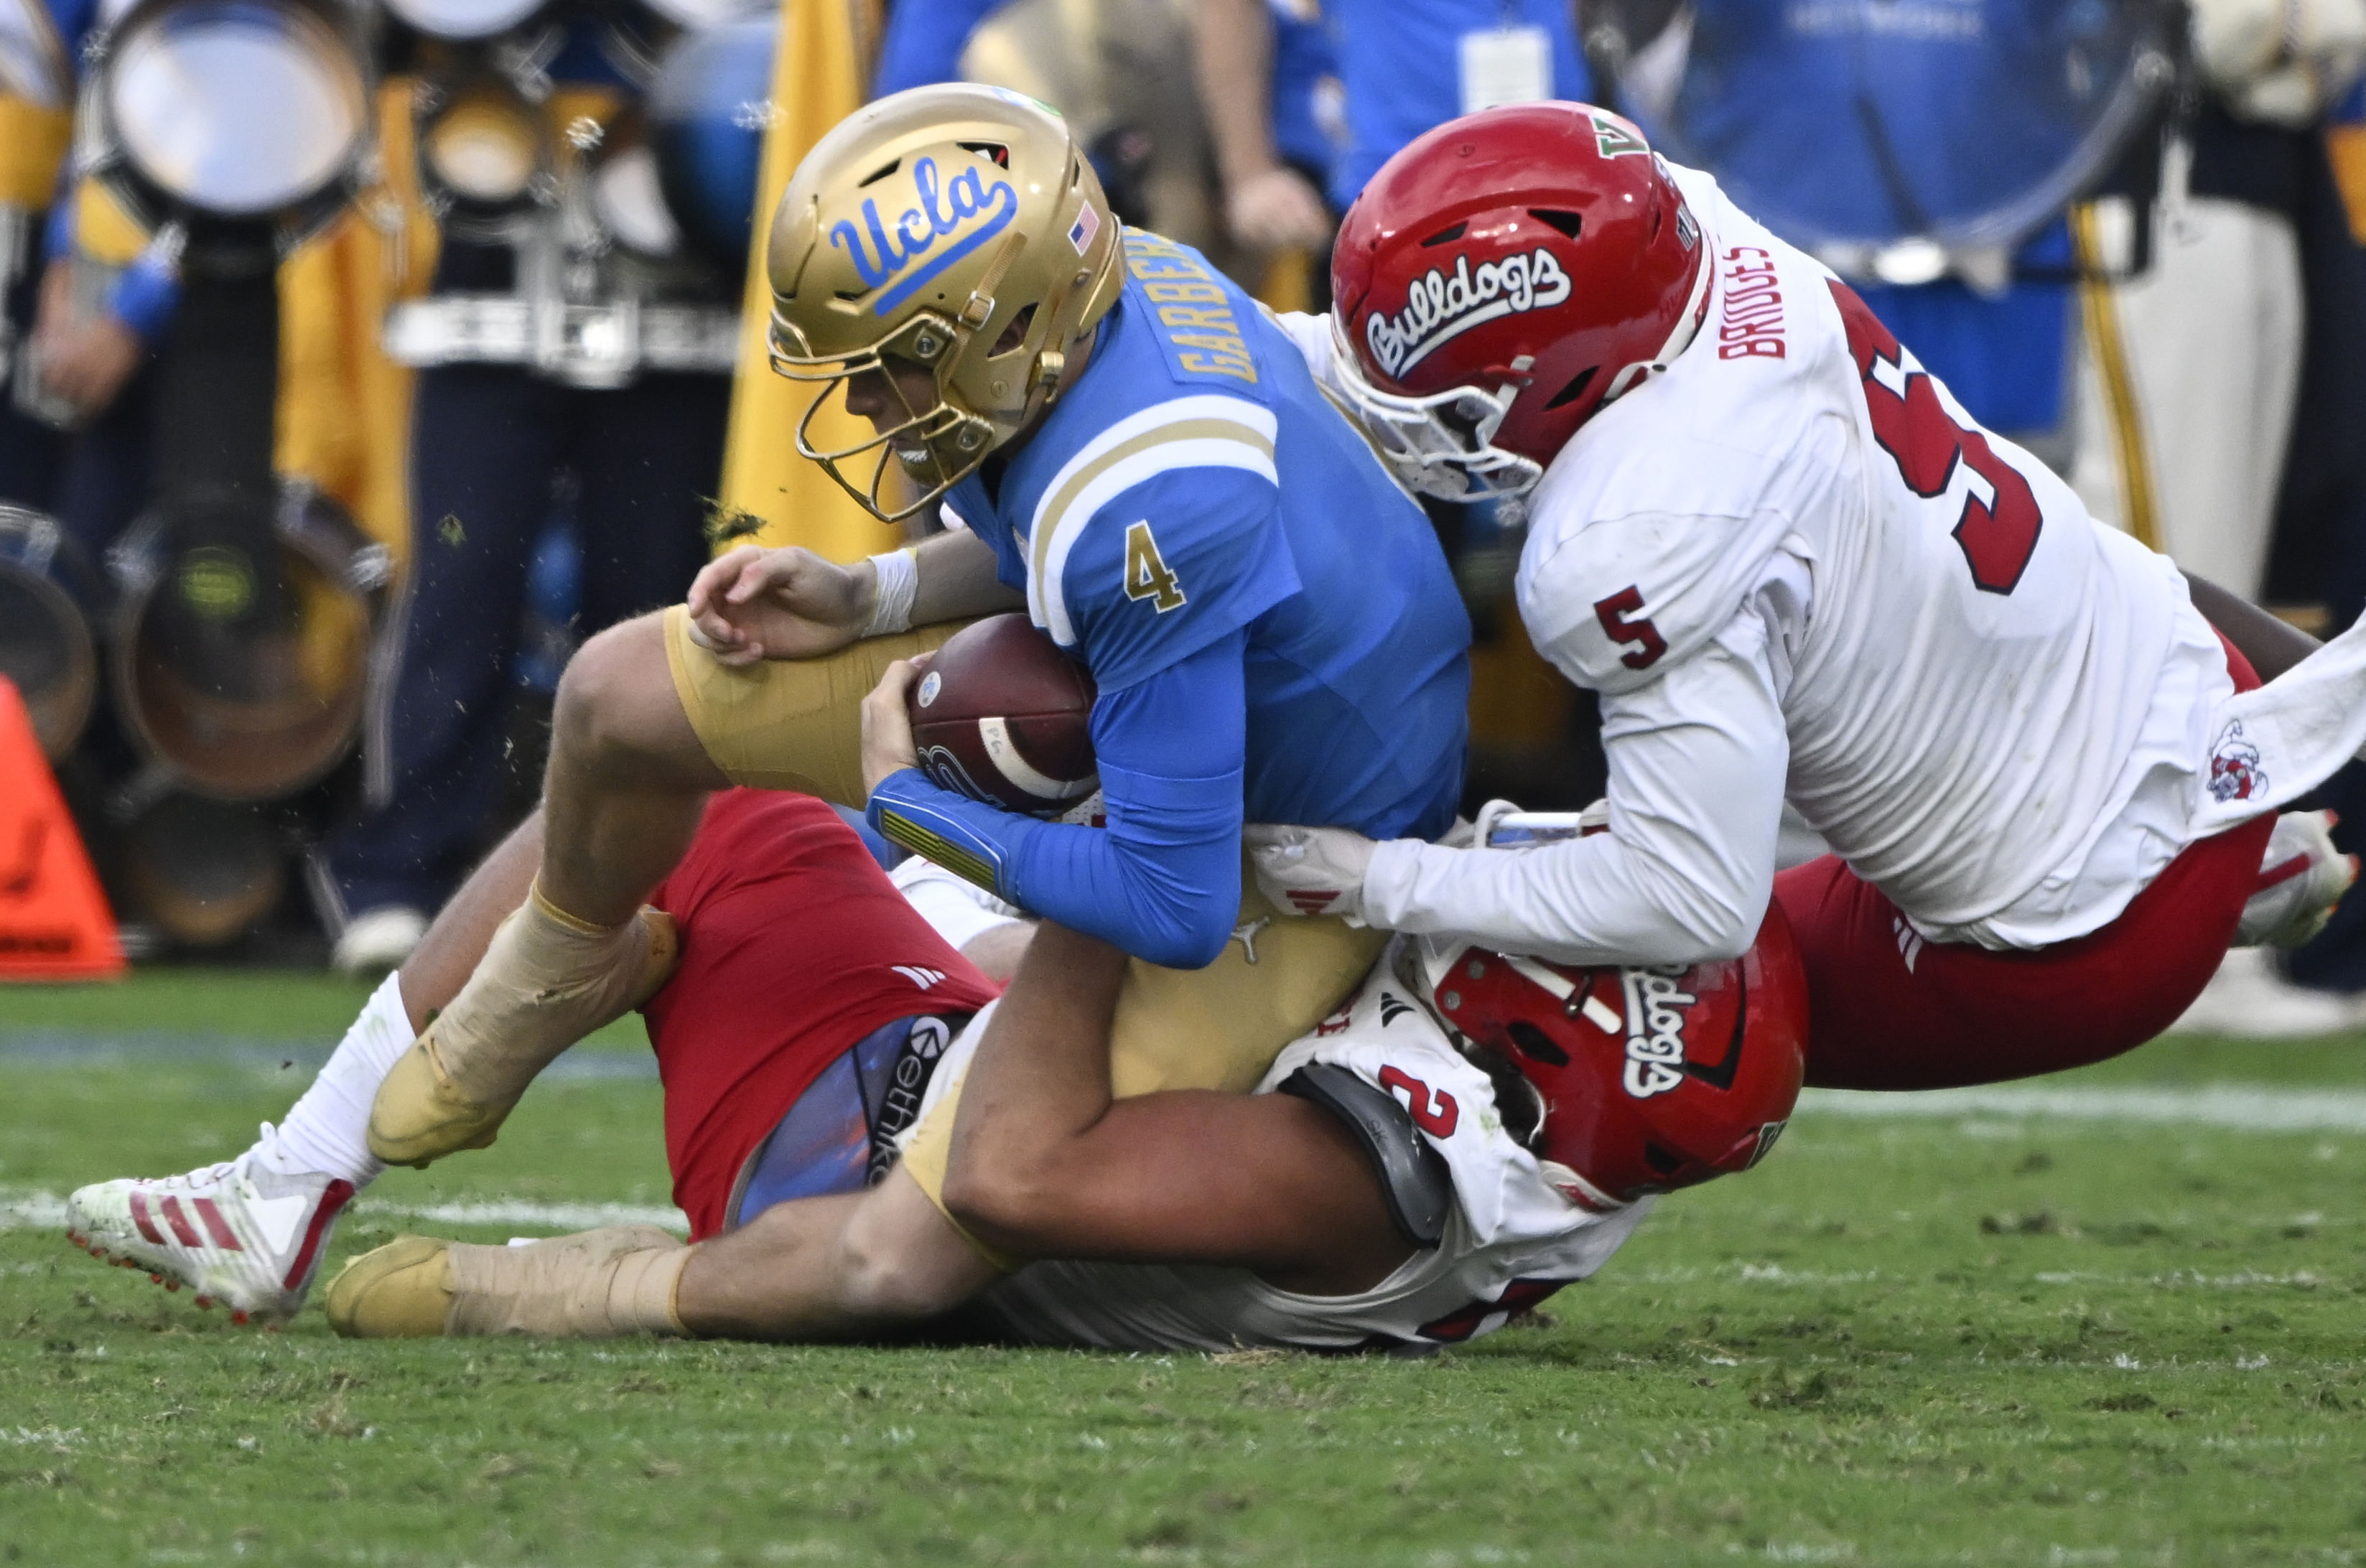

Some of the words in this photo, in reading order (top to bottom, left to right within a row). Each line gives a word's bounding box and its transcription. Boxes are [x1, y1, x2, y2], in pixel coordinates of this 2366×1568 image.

[830, 157, 1018, 316] Ucla
[1366, 248, 1572, 381] Bulldogs
[1124, 518, 1188, 614] 4
[1593, 584, 1667, 670] 5
[1622, 966, 1697, 1099] dogs
[1378, 1064, 1460, 1140] 2
